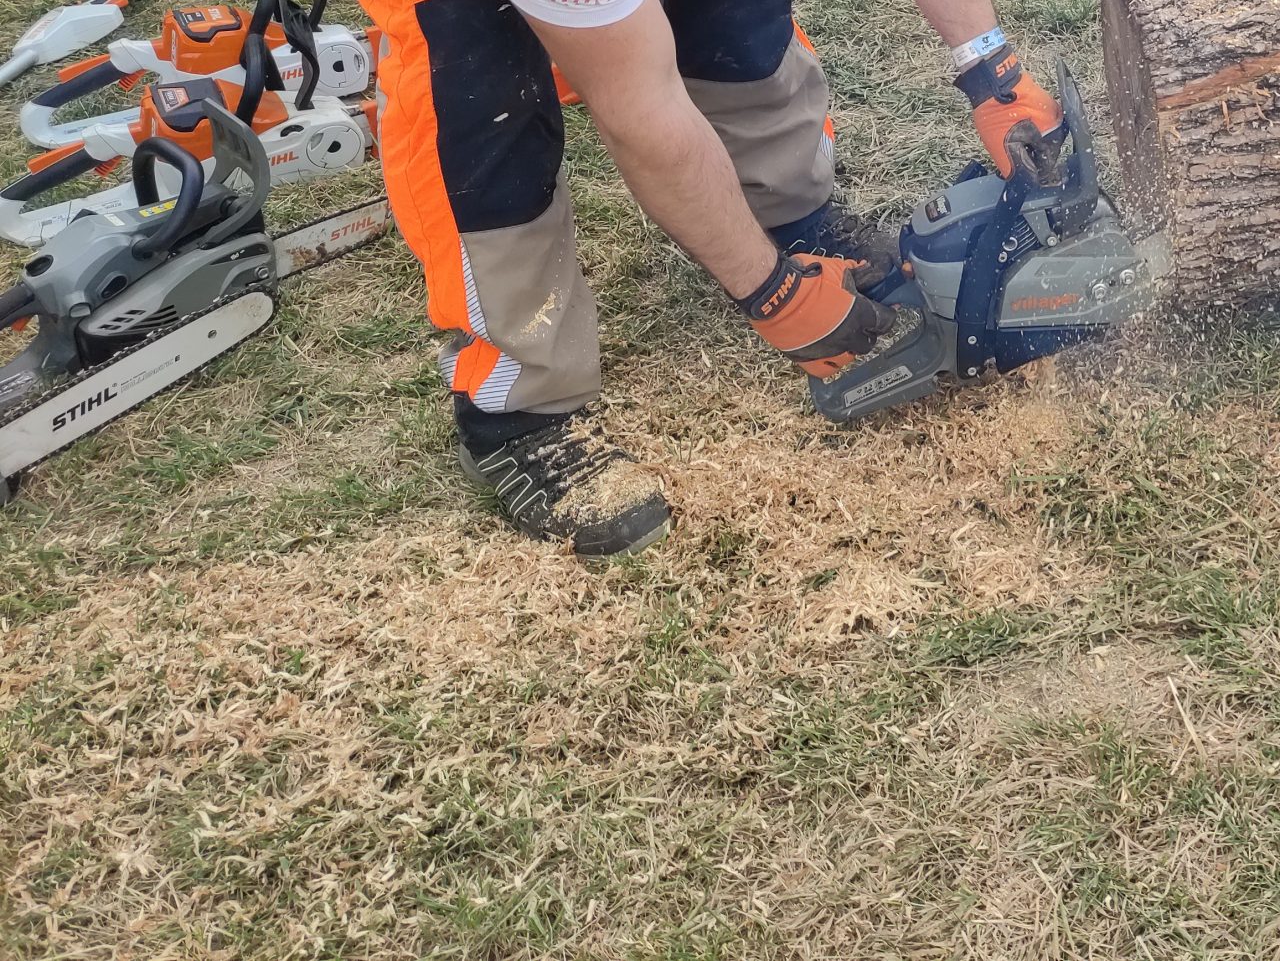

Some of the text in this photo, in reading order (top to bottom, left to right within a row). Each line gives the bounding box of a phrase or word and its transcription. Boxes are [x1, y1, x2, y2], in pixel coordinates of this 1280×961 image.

[281, 67, 305, 81] IHL
[269, 151, 300, 167] IHL
[330, 215, 377, 241] STIHL
[761, 271, 797, 316] STIHL
[51, 386, 119, 432] STIHL
